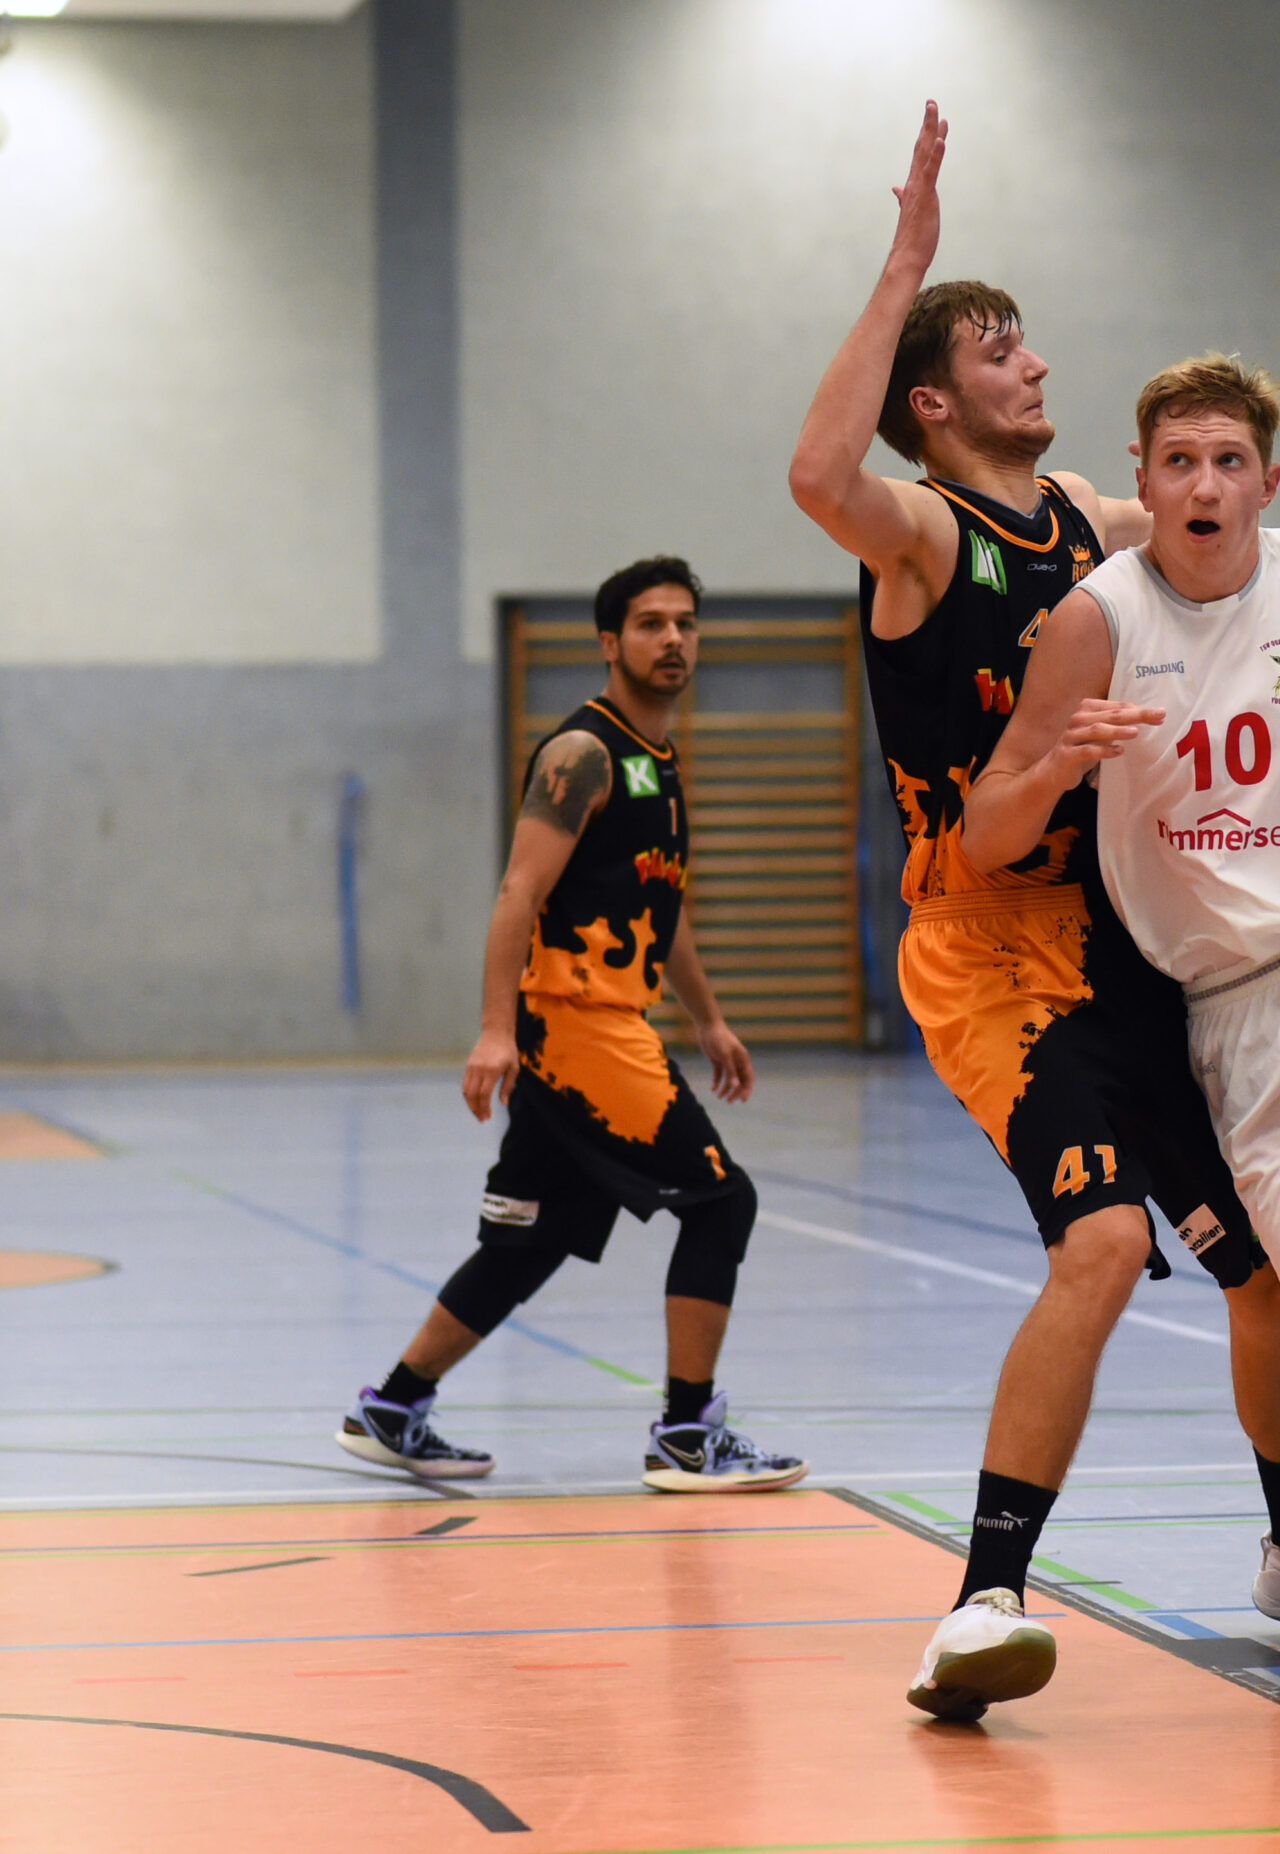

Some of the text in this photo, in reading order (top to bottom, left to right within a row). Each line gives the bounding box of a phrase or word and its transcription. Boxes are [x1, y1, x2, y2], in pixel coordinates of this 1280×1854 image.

[1135, 660, 1185, 679] SPALDING
[1176, 711, 1271, 792] 10
[625, 759, 658, 793] K
[703, 1145, 727, 1181] 1
[1052, 1144, 1118, 1200] 41
